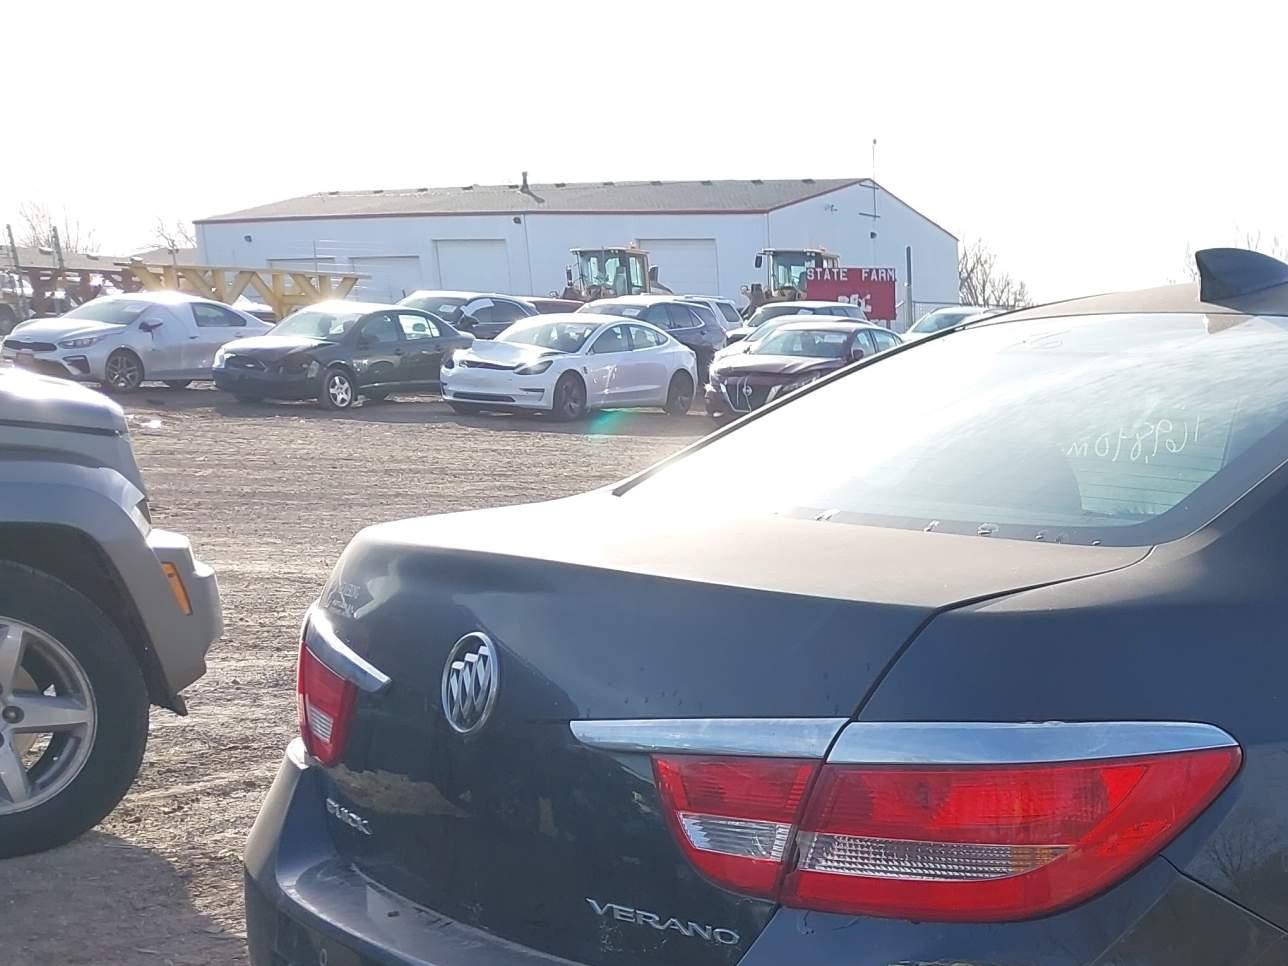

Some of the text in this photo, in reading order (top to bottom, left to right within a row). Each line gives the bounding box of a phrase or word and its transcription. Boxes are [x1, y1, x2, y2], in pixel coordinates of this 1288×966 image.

[806, 268, 895, 281] STATE FARM
[585, 897, 740, 945] VERANO
